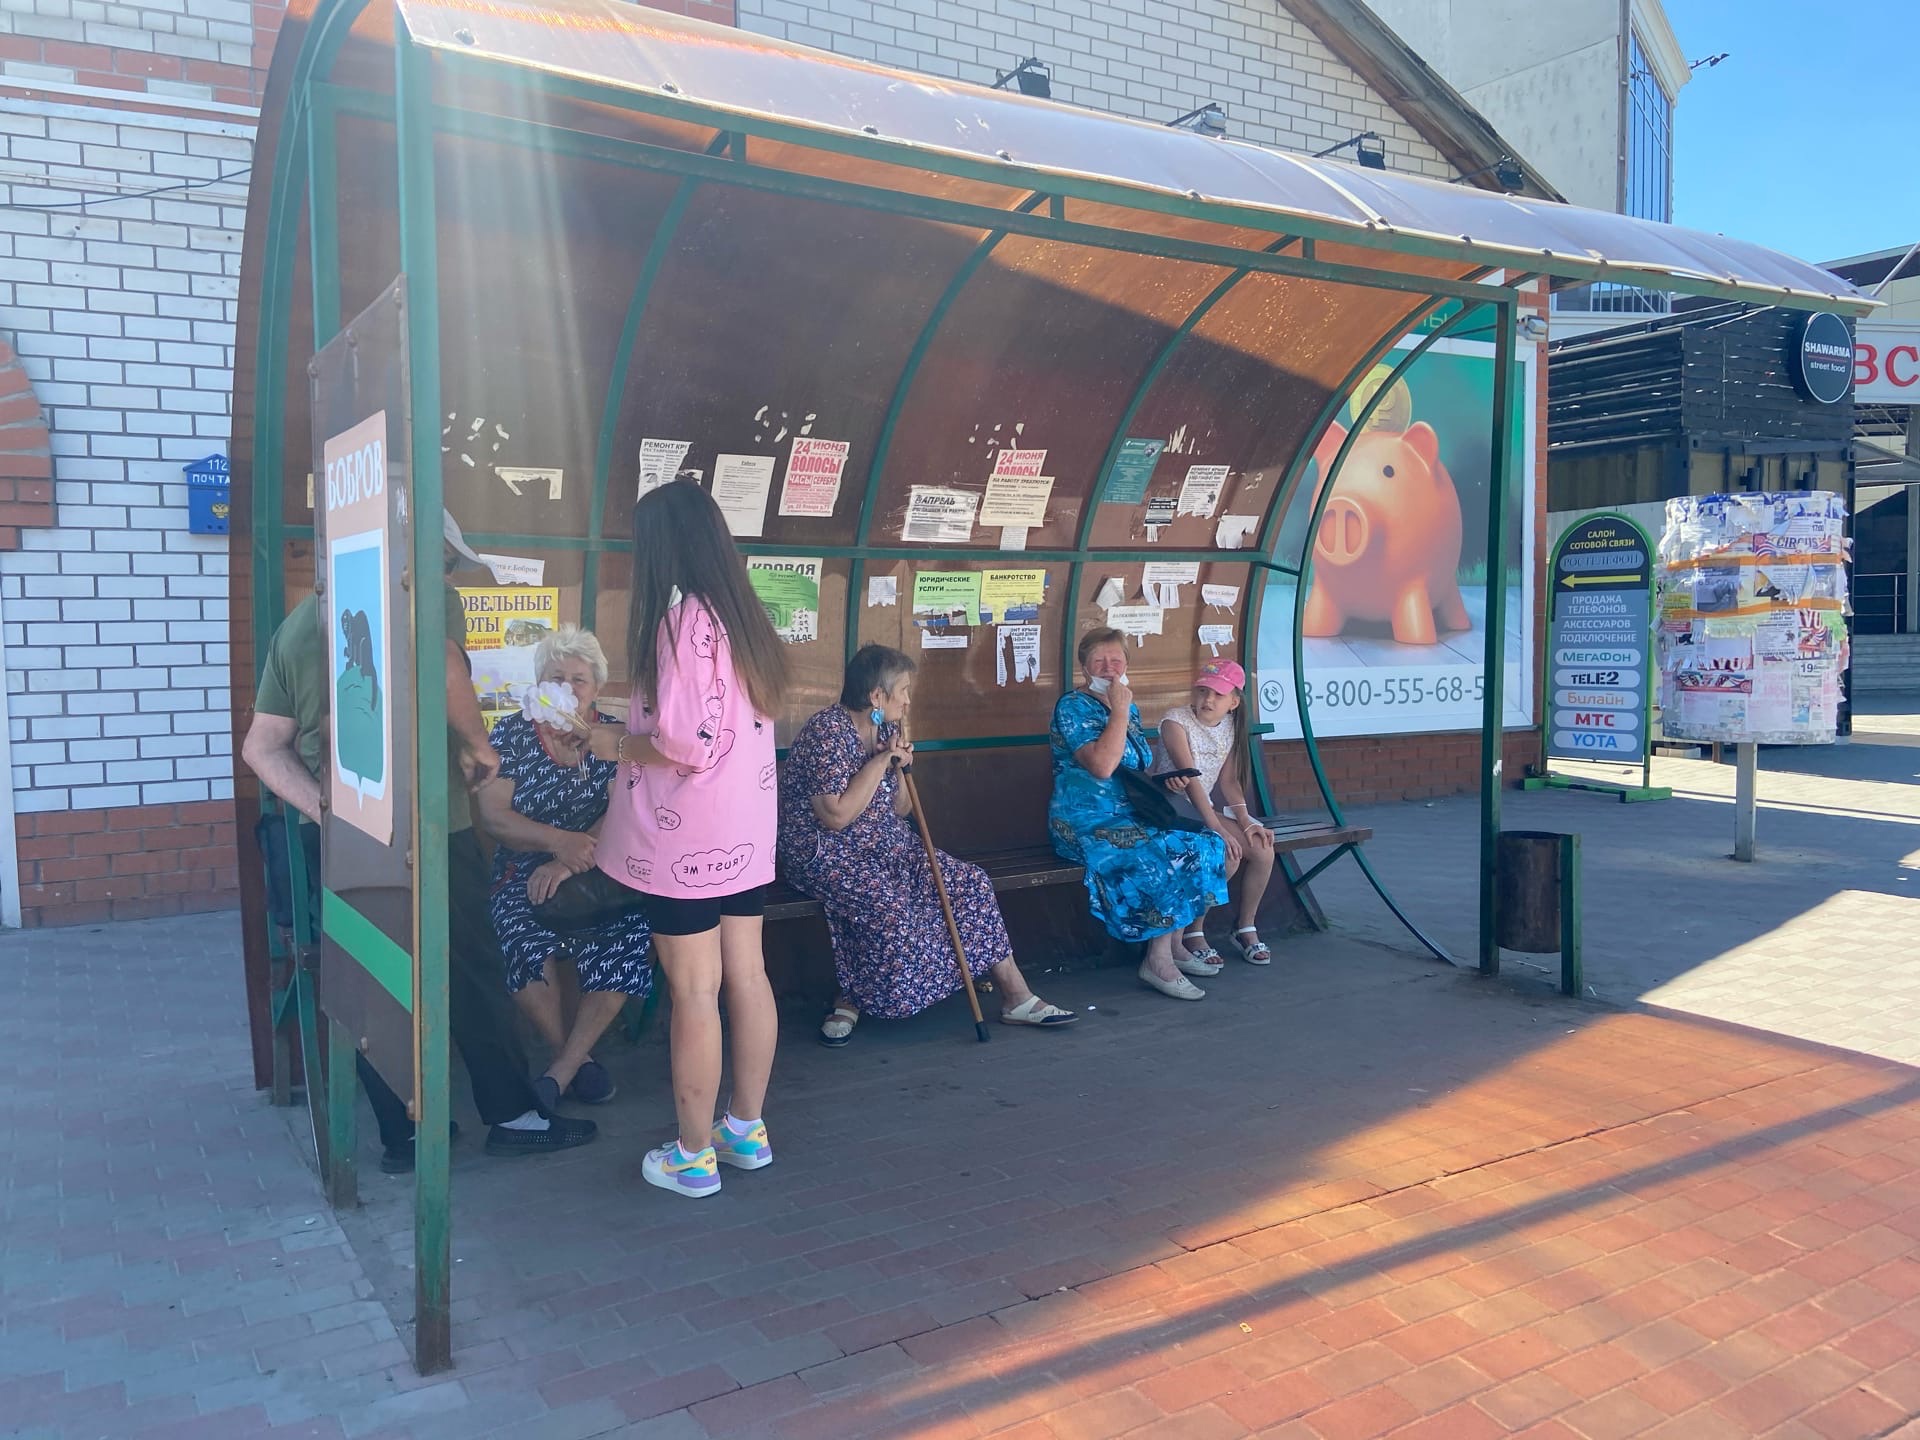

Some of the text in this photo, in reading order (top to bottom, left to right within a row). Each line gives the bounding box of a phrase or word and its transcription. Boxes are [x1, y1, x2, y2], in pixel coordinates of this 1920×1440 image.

[1804, 342, 1851, 359] SHAWARMA
[1810, 361, 1846, 373] street food
[644, 441, 675, 449] РЕМОНТ
[794, 440, 847, 455] 24 ИЮНЯ
[207, 459, 228, 471] 112
[790, 456, 842, 474] ВОЛОСЫ
[999, 452, 1014, 466] 24
[1015, 452, 1044, 461] ИЮНЯ
[192, 473, 230, 485] ПОЧТА
[327, 439, 384, 512] БОБРОВ
[789, 474, 837, 486] ЧАСЫ СЕРЕБРО
[1587, 529, 1616, 539] САЛОН
[1569, 538, 1635, 550] СОТОВОЙ СВЯЗИ
[458, 595, 552, 612] ОВЕЛЬНЫЕ
[1572, 595, 1622, 605] ПРОДАЖА
[1567, 604, 1627, 615] ТЕЛЕФОНОВ
[465, 616, 500, 633] ОТЫ
[1563, 619, 1631, 630] АКСЕССУАРОВ
[1560, 633, 1637, 644] ПОДКЛЮЧЕНИЕ
[1800, 663, 1814, 673] 19
[1571, 671, 1619, 685] TELE2
[1303, 675, 1485, 708] 8-800-555-68-5
[1567, 692, 1624, 705] Билайн
[1575, 712, 1615, 727] МТС
[1572, 733, 1618, 748] YOTA
